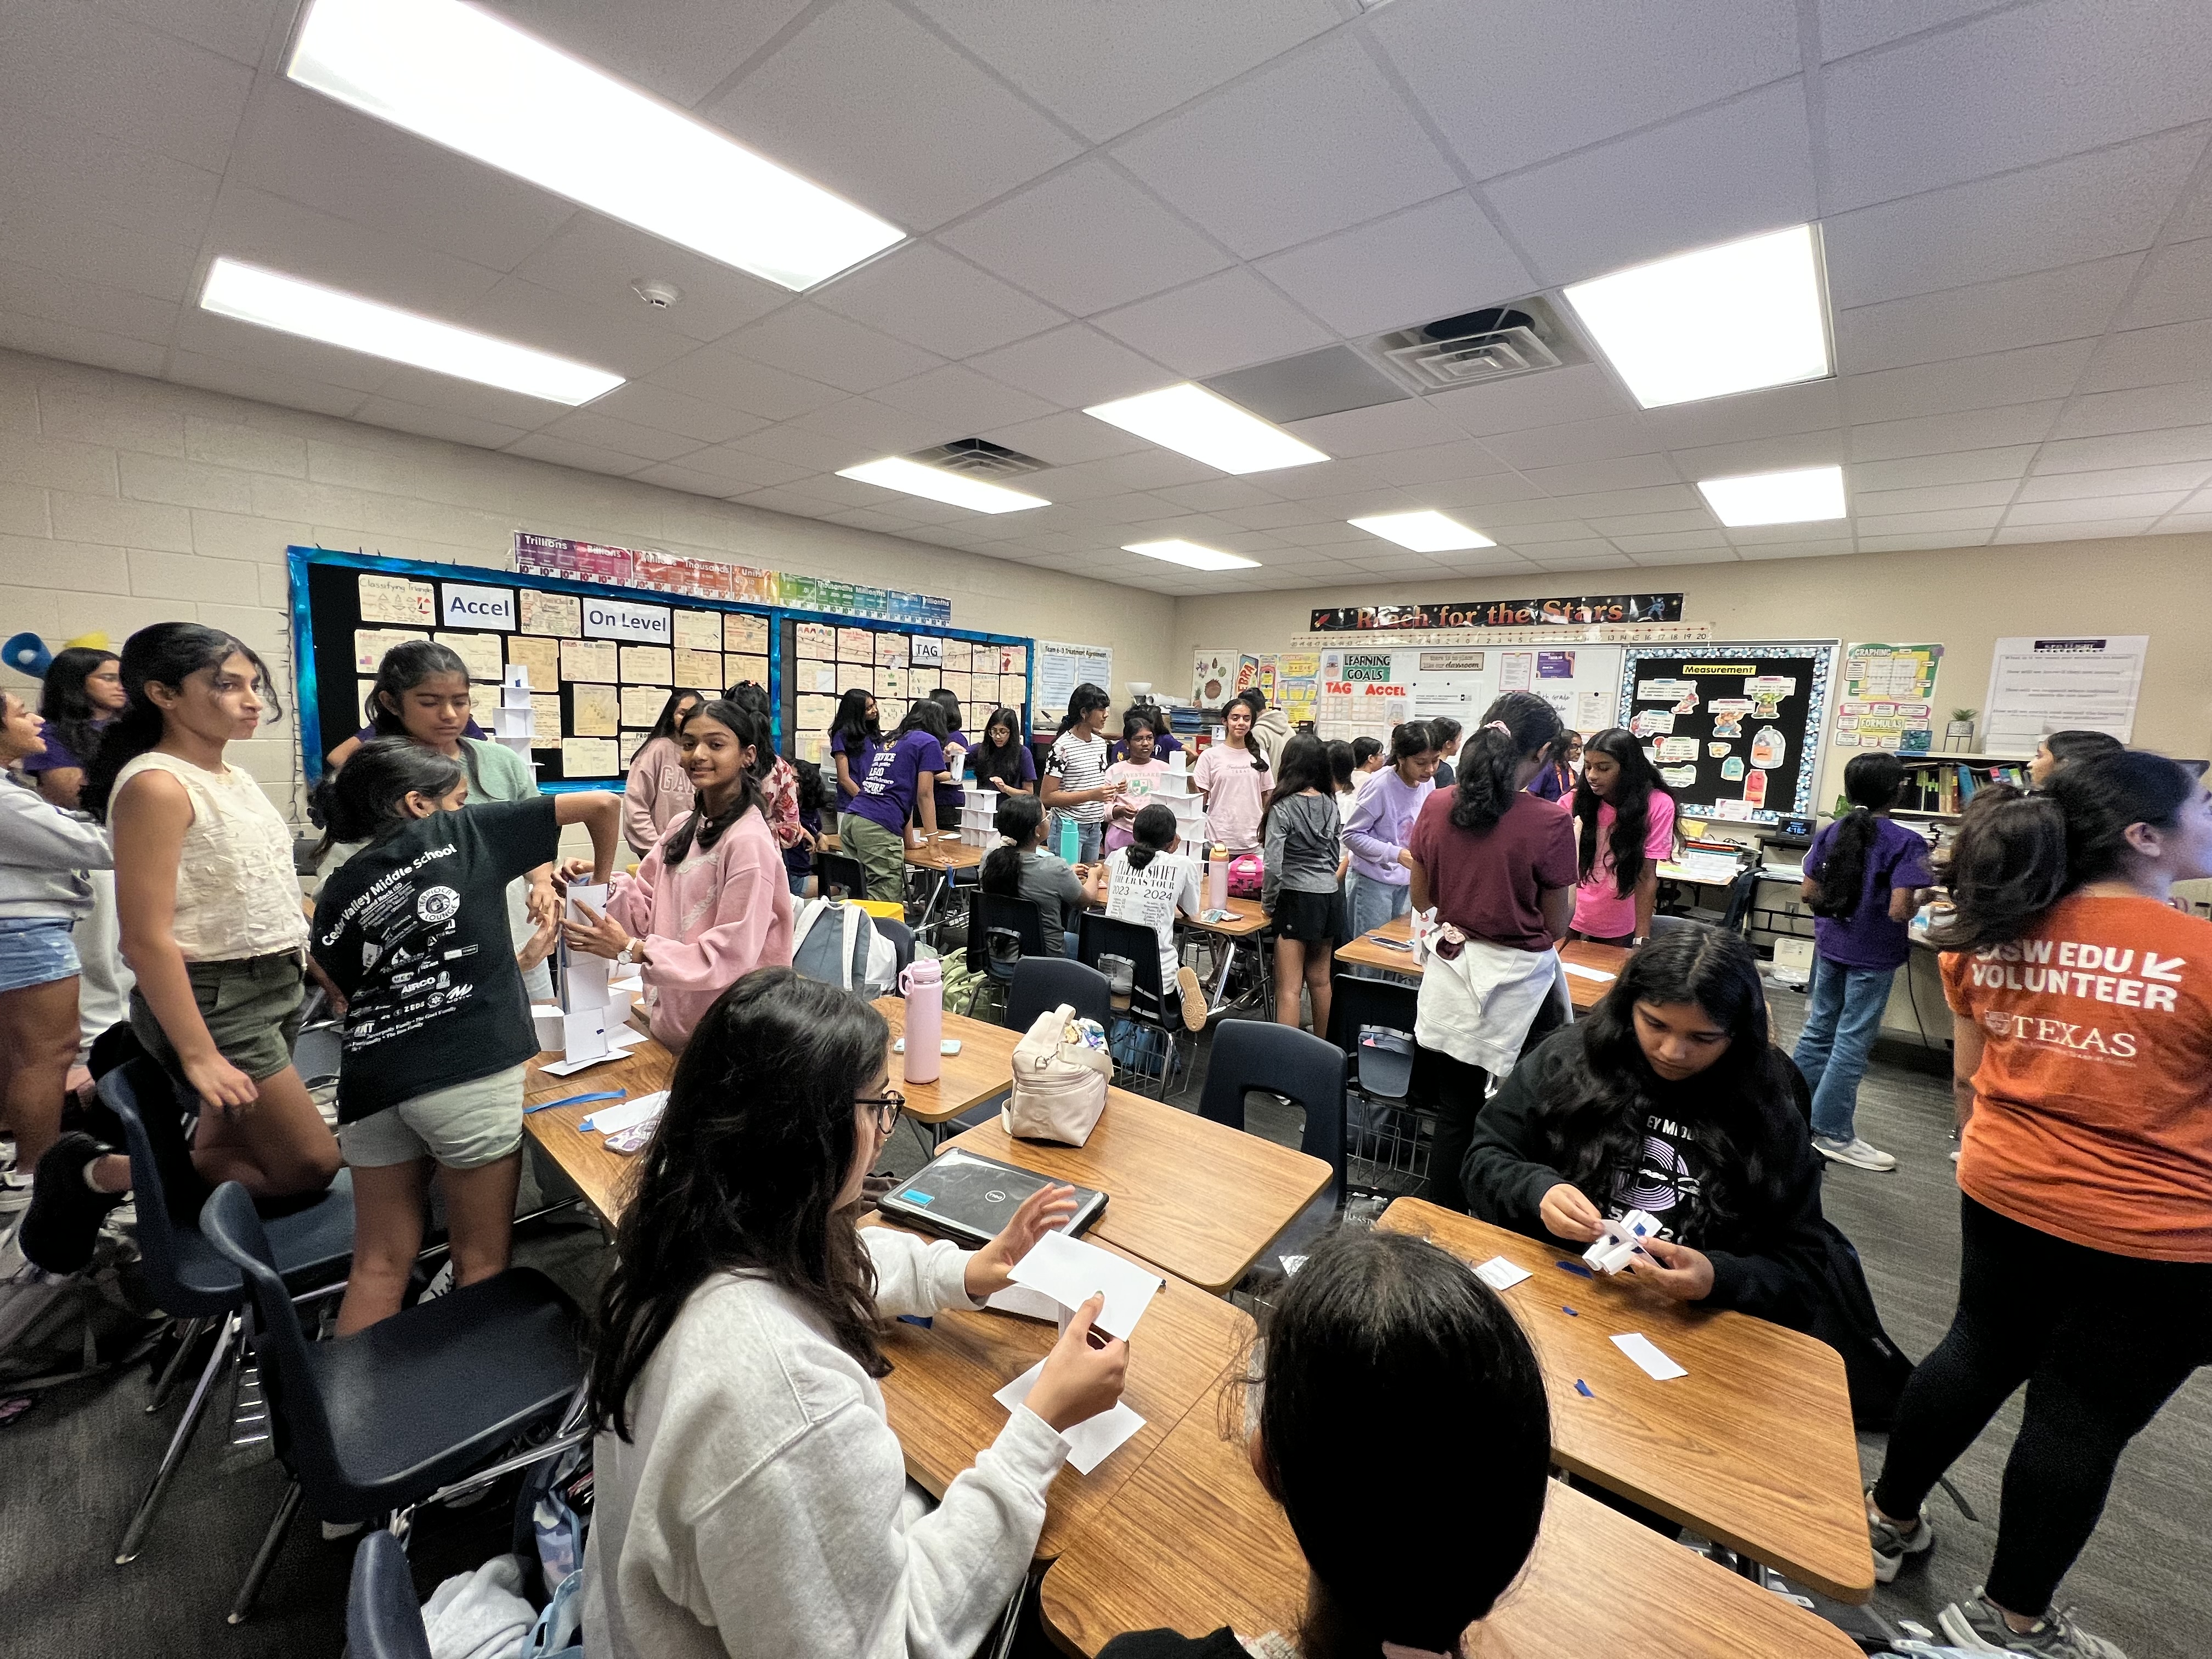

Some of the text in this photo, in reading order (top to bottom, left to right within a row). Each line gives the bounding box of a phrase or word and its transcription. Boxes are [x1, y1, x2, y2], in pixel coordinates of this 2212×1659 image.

[525, 535, 568, 550] Trillions
[588, 545, 621, 557] Billions
[686, 562, 729, 574] Thousands
[359, 578, 405, 593] Classifying
[450, 596, 509, 617] Accel
[1438, 605, 1477, 627] for
[1487, 603, 1530, 624] the
[1543, 600, 1623, 623] Stars
[589, 610, 616, 626] On
[622, 613, 666, 631] Level
[916, 644, 938, 657] TAG
[1855, 648, 1892, 657] GRAPHING
[1344, 654, 1391, 667] LEARNING
[1347, 669, 1383, 681] GOALS
[1325, 682, 1406, 696] TAG ACCEL
[1860, 719, 1902, 729] FORMULAS
[659, 765, 696, 794] GA
[1146, 865, 1178, 881] SWIFT
[342, 891, 371, 920] Valley
[370, 866, 413, 896] Middle
[413, 843, 458, 869] School
[1125, 876, 1148, 886] ERAS
[1150, 879, 1175, 889] TOUR
[1113, 885, 1130, 895] 2023
[1144, 889, 1172, 901] 2024
[425, 904, 458, 921] LOUNGE
[2059, 941, 2135, 973] EDU
[401, 977, 436, 994] AIRCO
[1972, 963, 2178, 1013] VOLUNTEER
[2012, 1014, 2136, 1058] TEXAS
